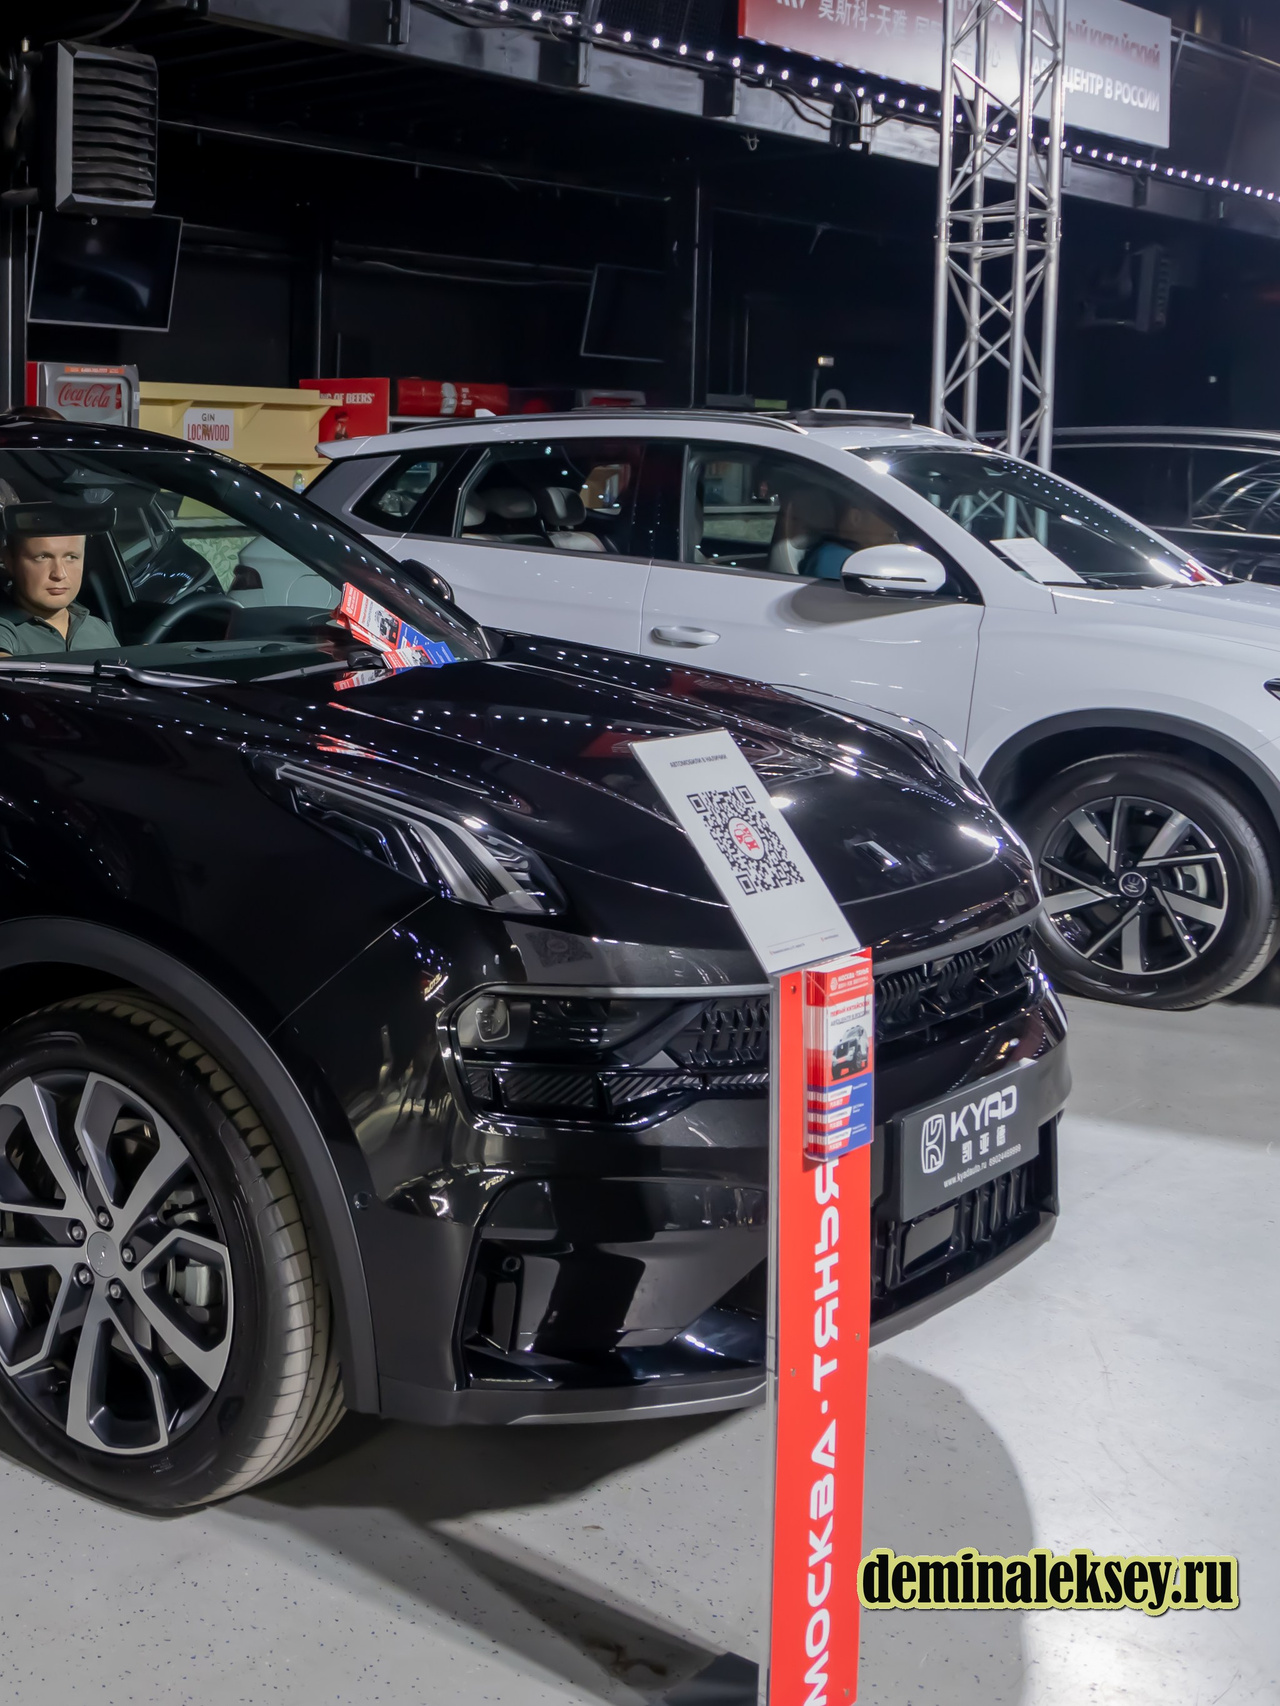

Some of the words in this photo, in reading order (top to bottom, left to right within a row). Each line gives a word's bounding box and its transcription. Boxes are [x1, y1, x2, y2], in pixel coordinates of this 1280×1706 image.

[1104, 77, 1113, 99] В
[1114, 80, 1160, 112] РОССИИ
[201, 413, 216, 422] GIN
[950, 1084, 1017, 1142] KYAD
